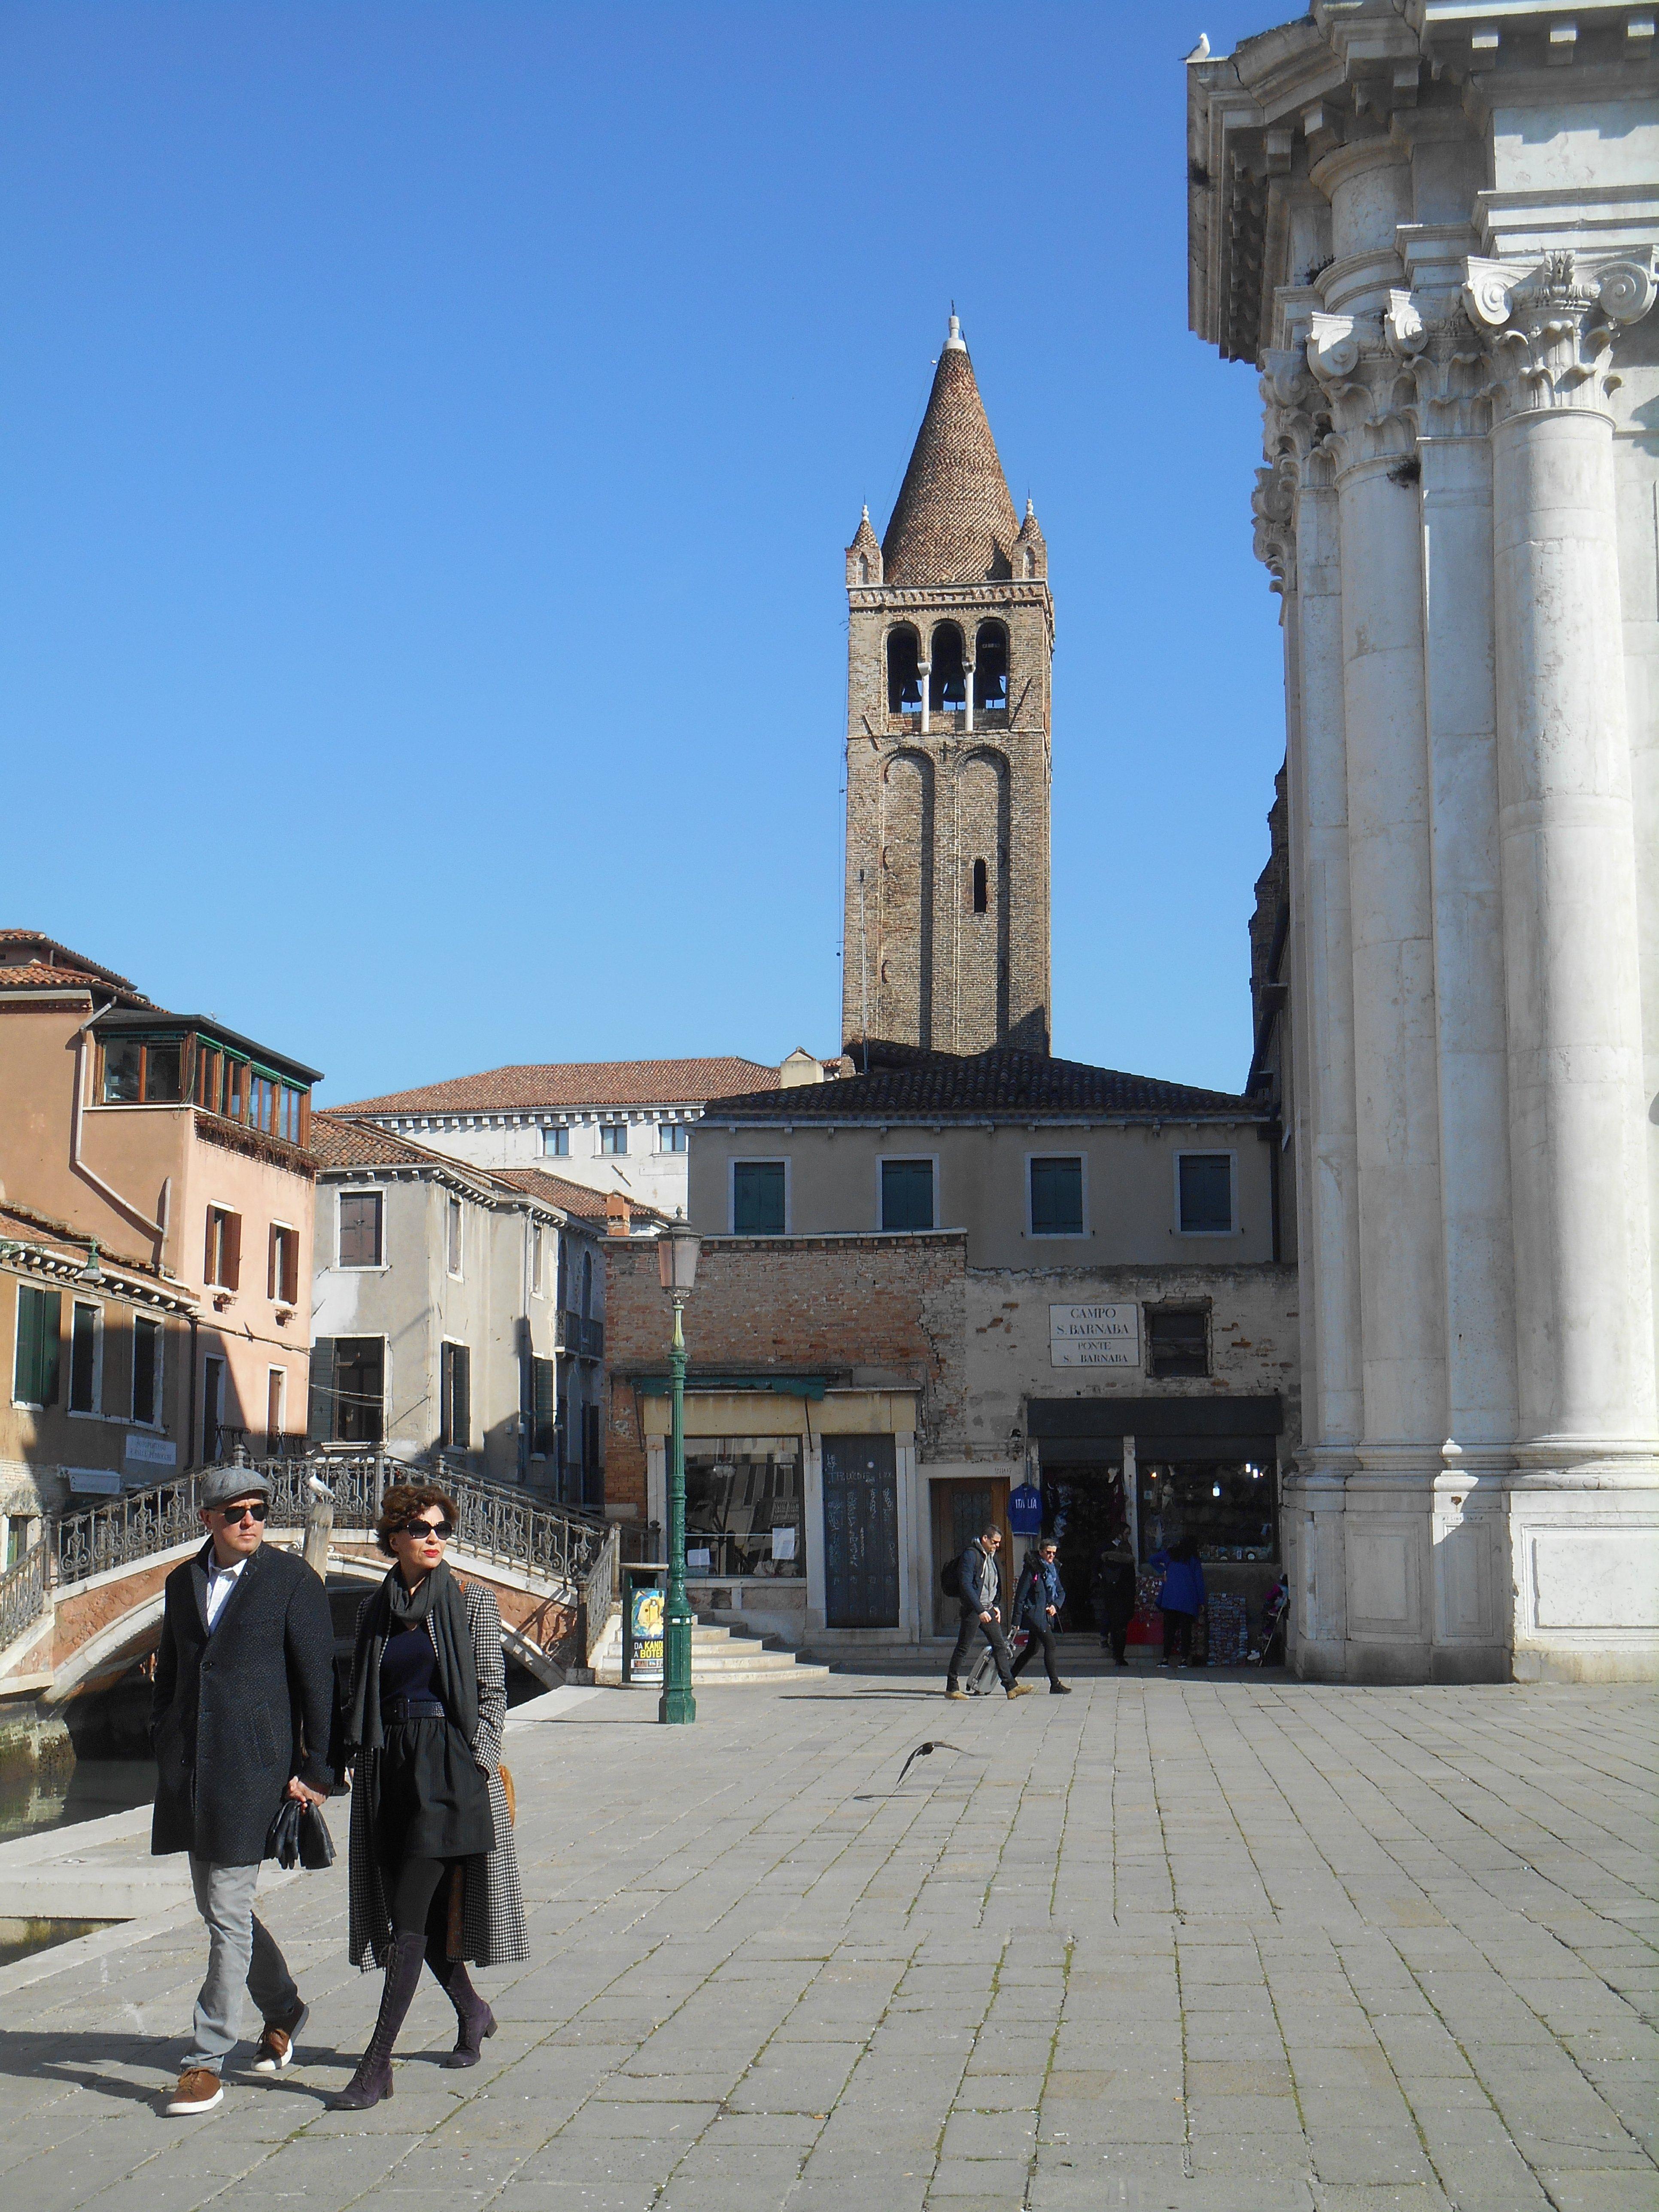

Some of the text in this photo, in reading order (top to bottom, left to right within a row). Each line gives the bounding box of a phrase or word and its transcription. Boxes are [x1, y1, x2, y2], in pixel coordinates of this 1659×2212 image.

[1071, 1308, 1116, 1318] CAMPO
[1057, 1324, 1129, 1335] S. BARNABA
[1078, 1342, 1111, 1350] PONTE
[1063, 1354, 1128, 1363] S. BARNABA
[1015, 1498, 1037, 1509] ITALIA
